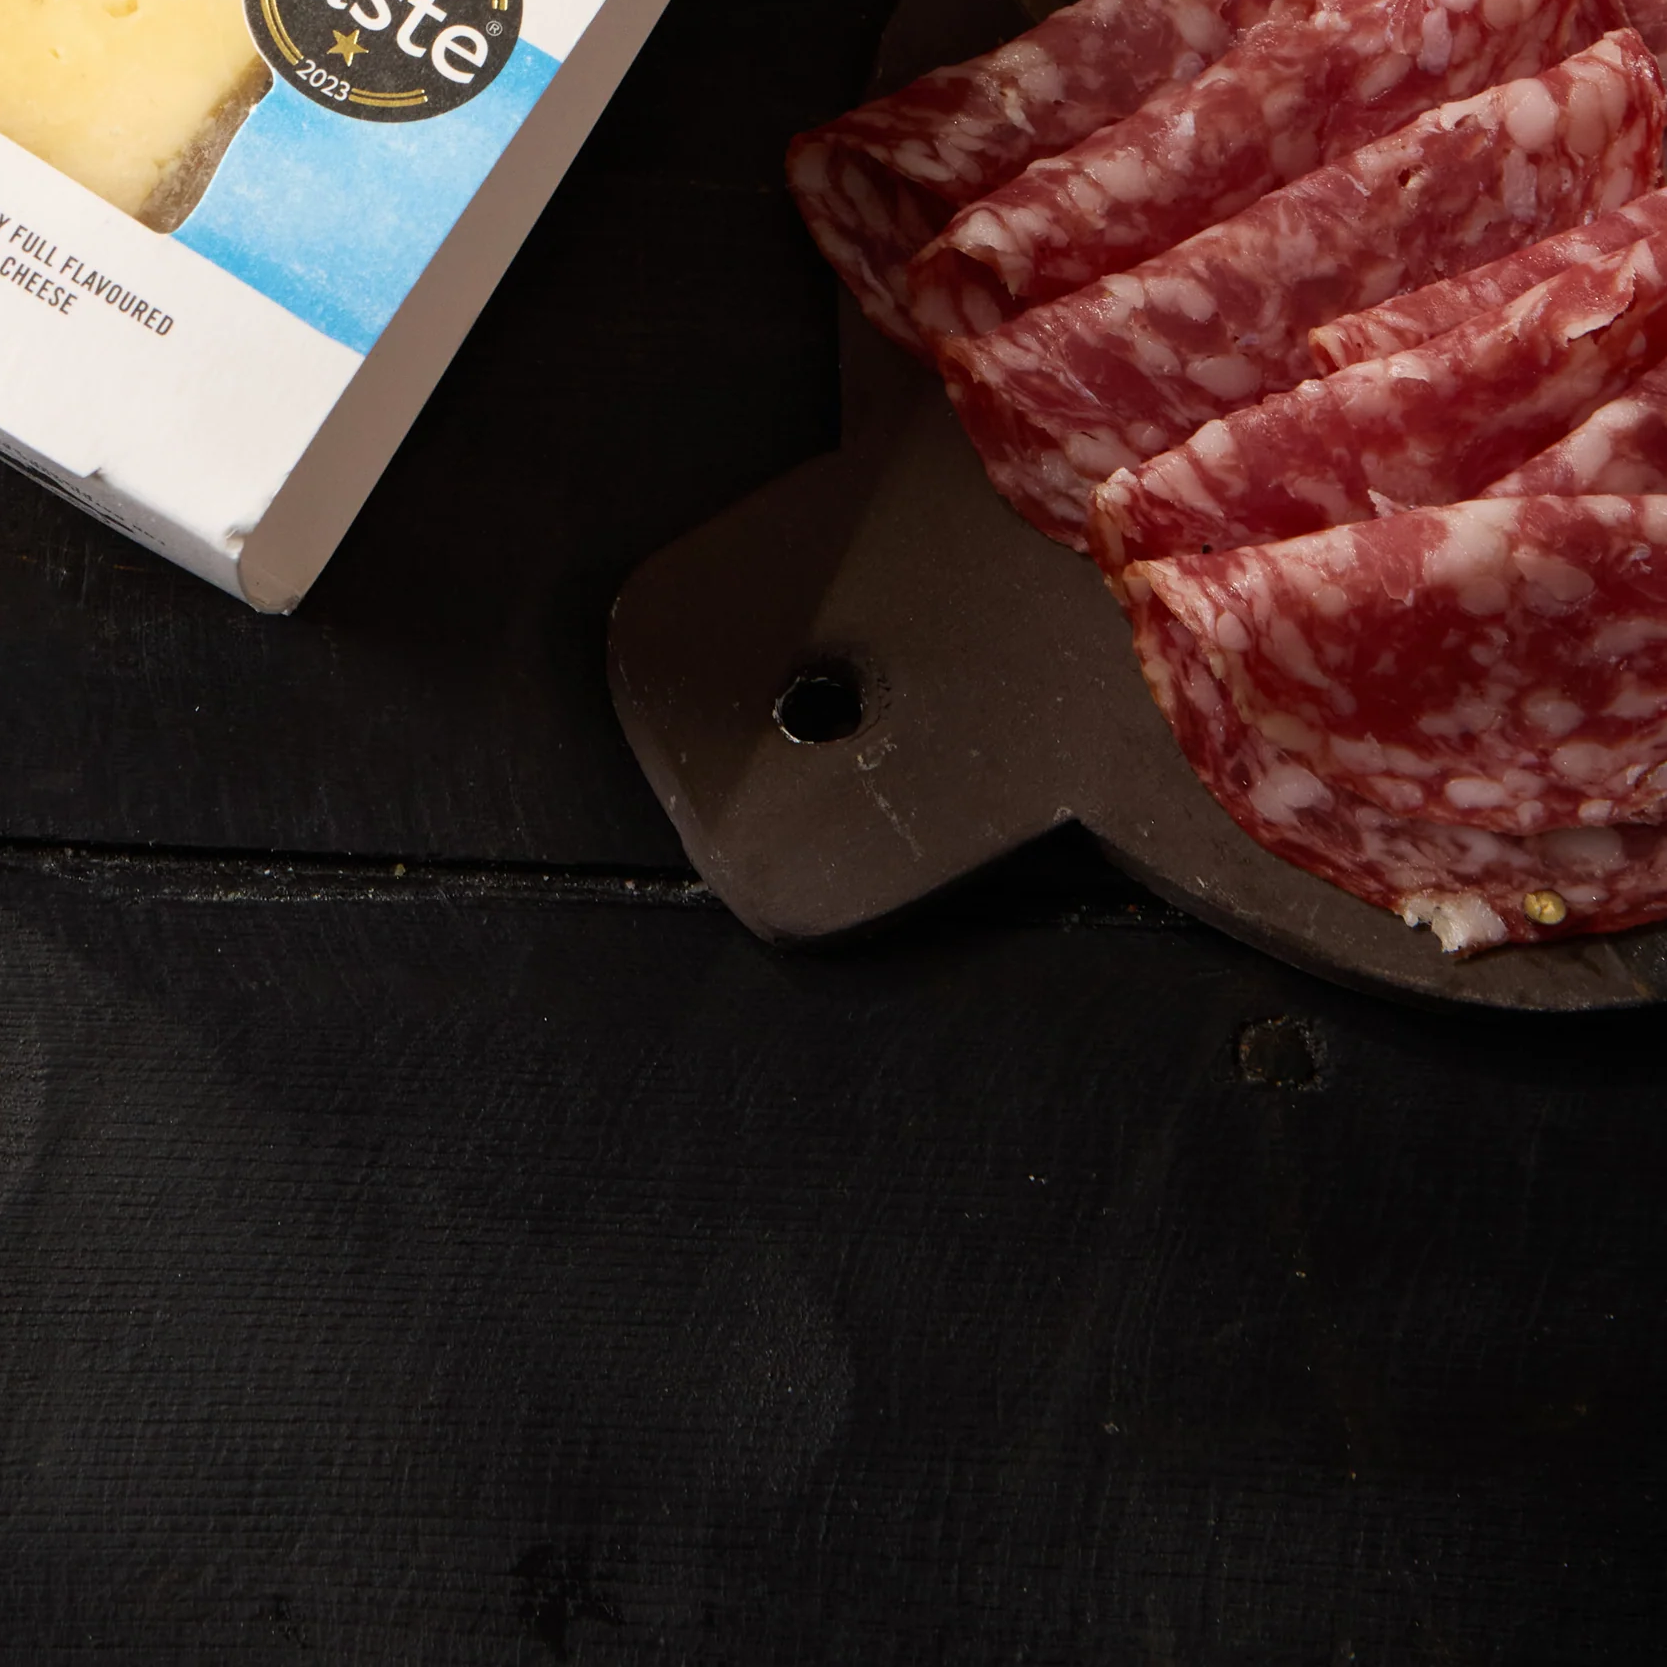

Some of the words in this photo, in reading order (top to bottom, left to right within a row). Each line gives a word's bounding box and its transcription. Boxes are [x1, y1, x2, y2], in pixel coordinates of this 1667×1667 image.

[295, 59, 352, 102] 2023
[0, 255, 79, 316] CHEESE
[9, 224, 65, 268] FULL
[60, 255, 175, 338] FLAVOURED
